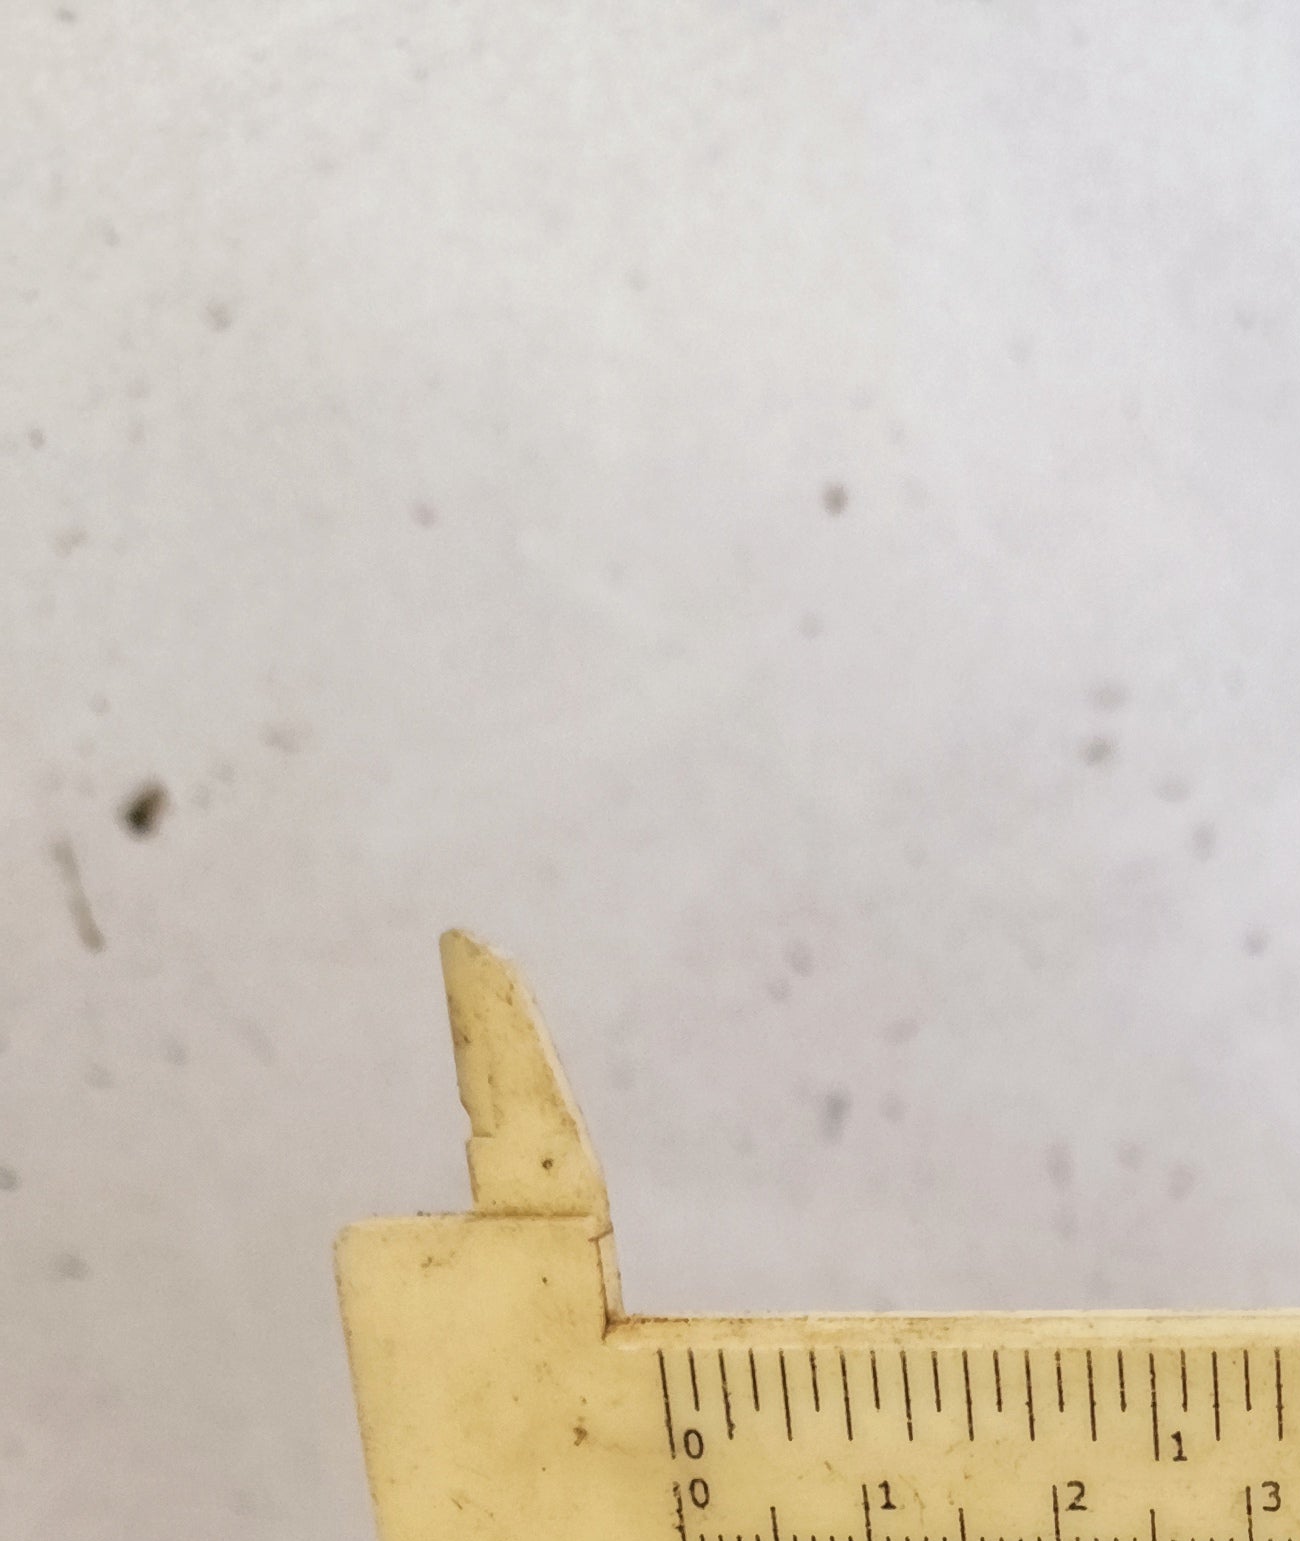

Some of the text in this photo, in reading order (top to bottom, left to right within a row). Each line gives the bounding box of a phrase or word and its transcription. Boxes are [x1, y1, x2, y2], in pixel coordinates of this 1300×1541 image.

[683, 1428, 704, 1460] 0
[1170, 1430, 1188, 1462] 1
[688, 1478, 710, 1509] 0
[878, 1480, 897, 1510] 1
[1065, 1480, 1088, 1512] 2
[1261, 1480, 1282, 1513] 3
